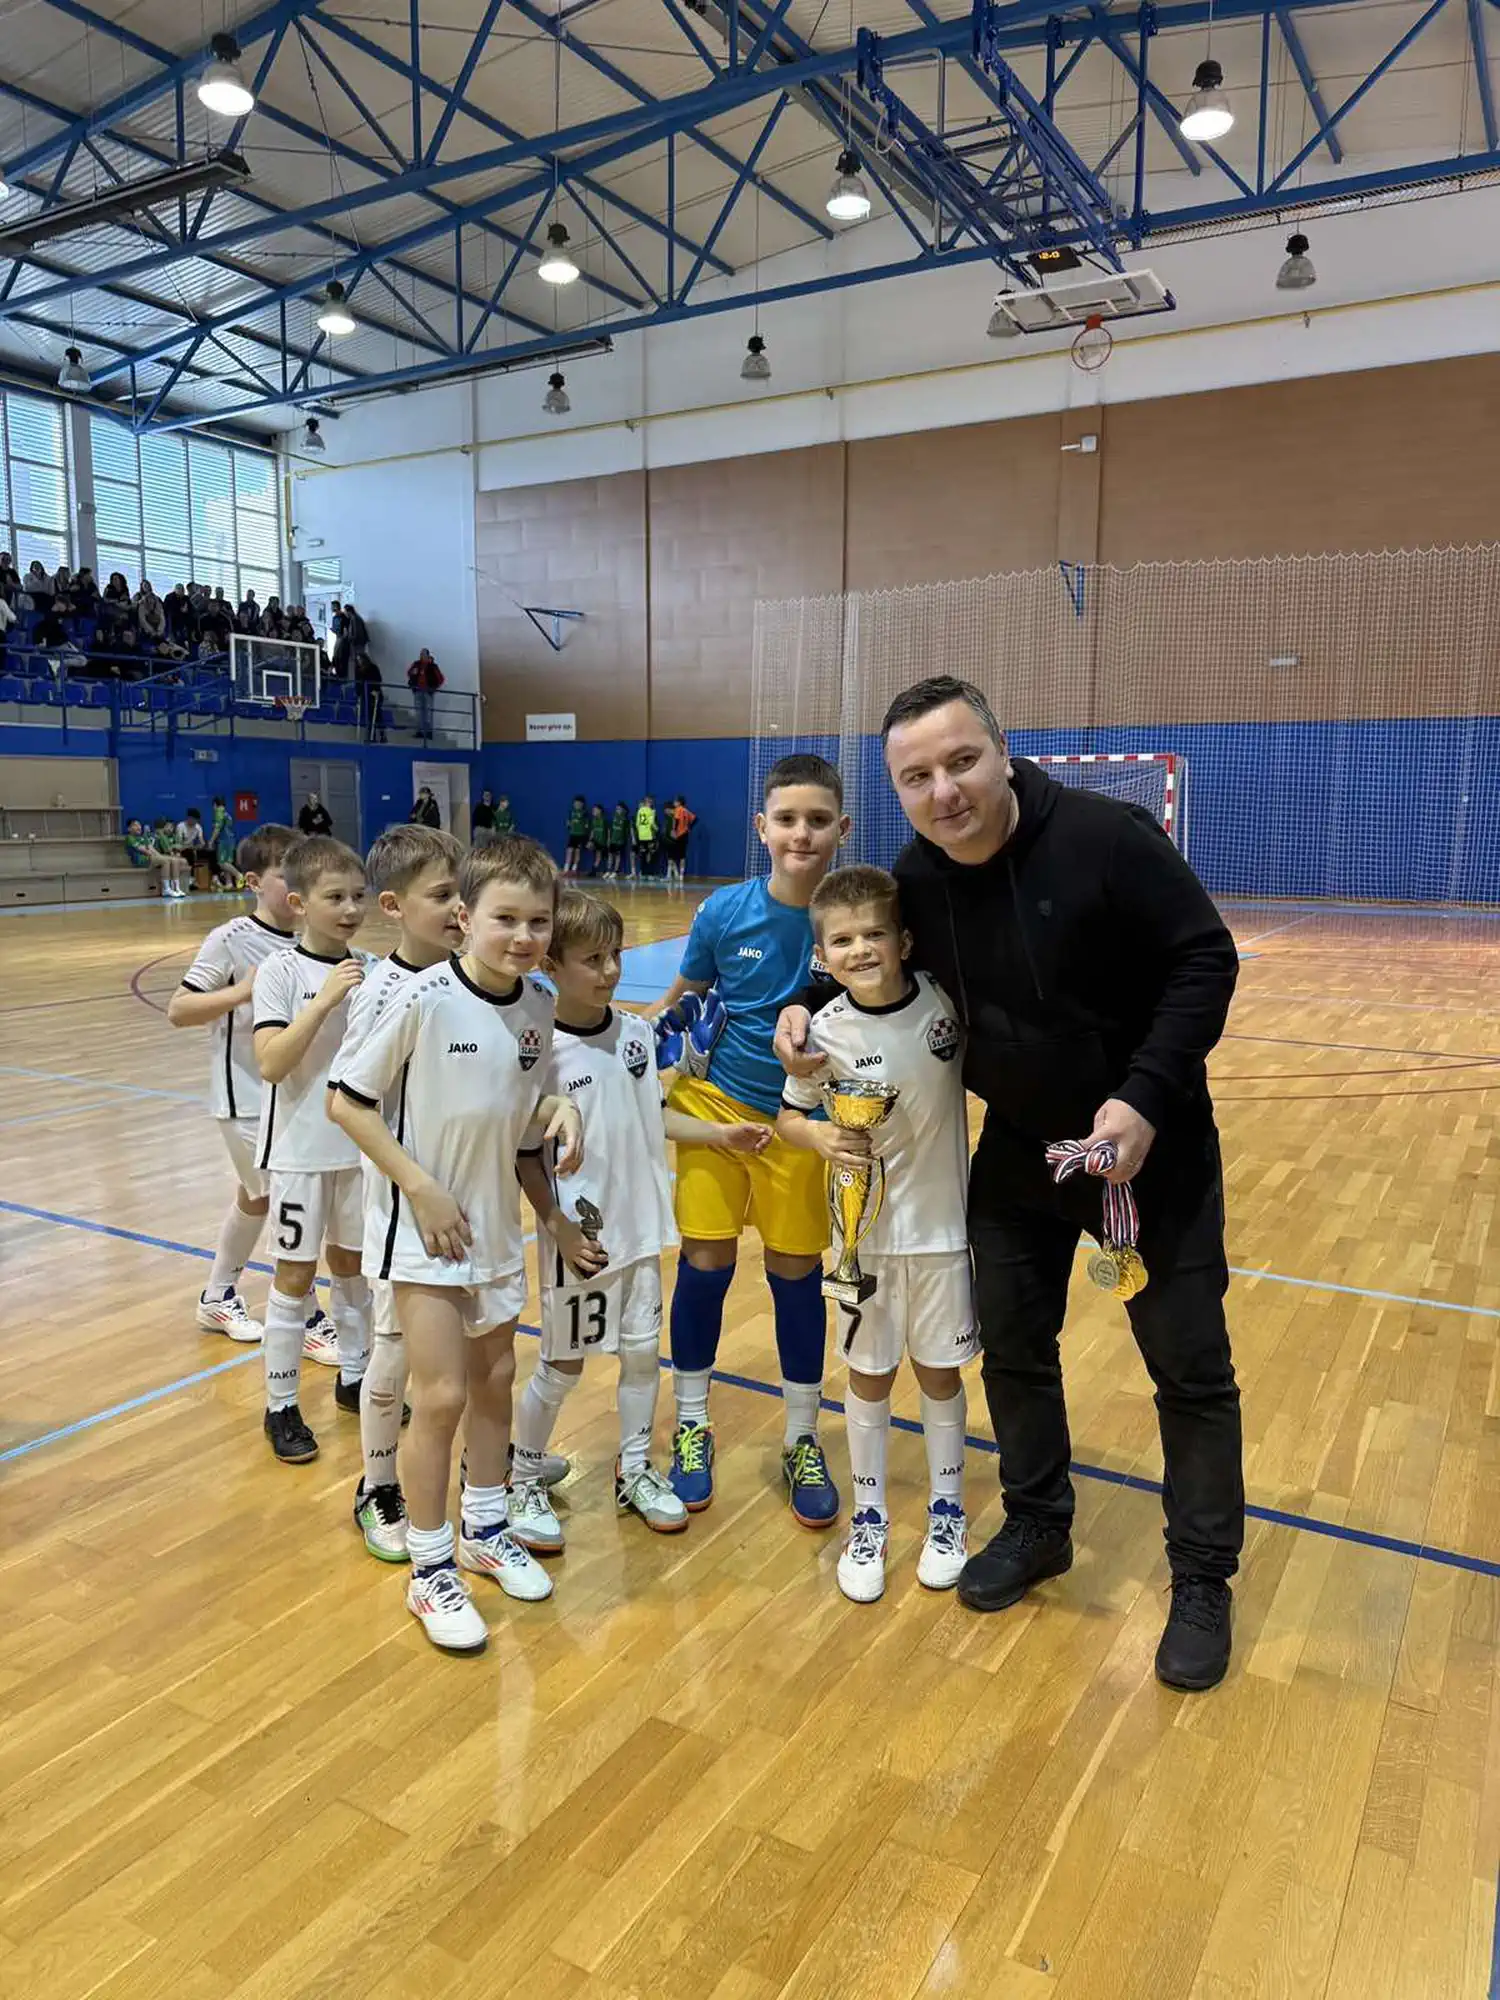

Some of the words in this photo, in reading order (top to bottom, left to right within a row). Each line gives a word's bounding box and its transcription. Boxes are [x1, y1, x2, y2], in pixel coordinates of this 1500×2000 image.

[738, 947, 763, 959] JAKO
[448, 1043, 479, 1054] JAKO
[855, 1055, 882, 1069] JAKO
[568, 1076, 592, 1092] JAKO
[278, 1202, 305, 1250] 5
[565, 1291, 607, 1349] 13
[839, 1301, 862, 1356] 7
[268, 1369, 298, 1380] JAKO
